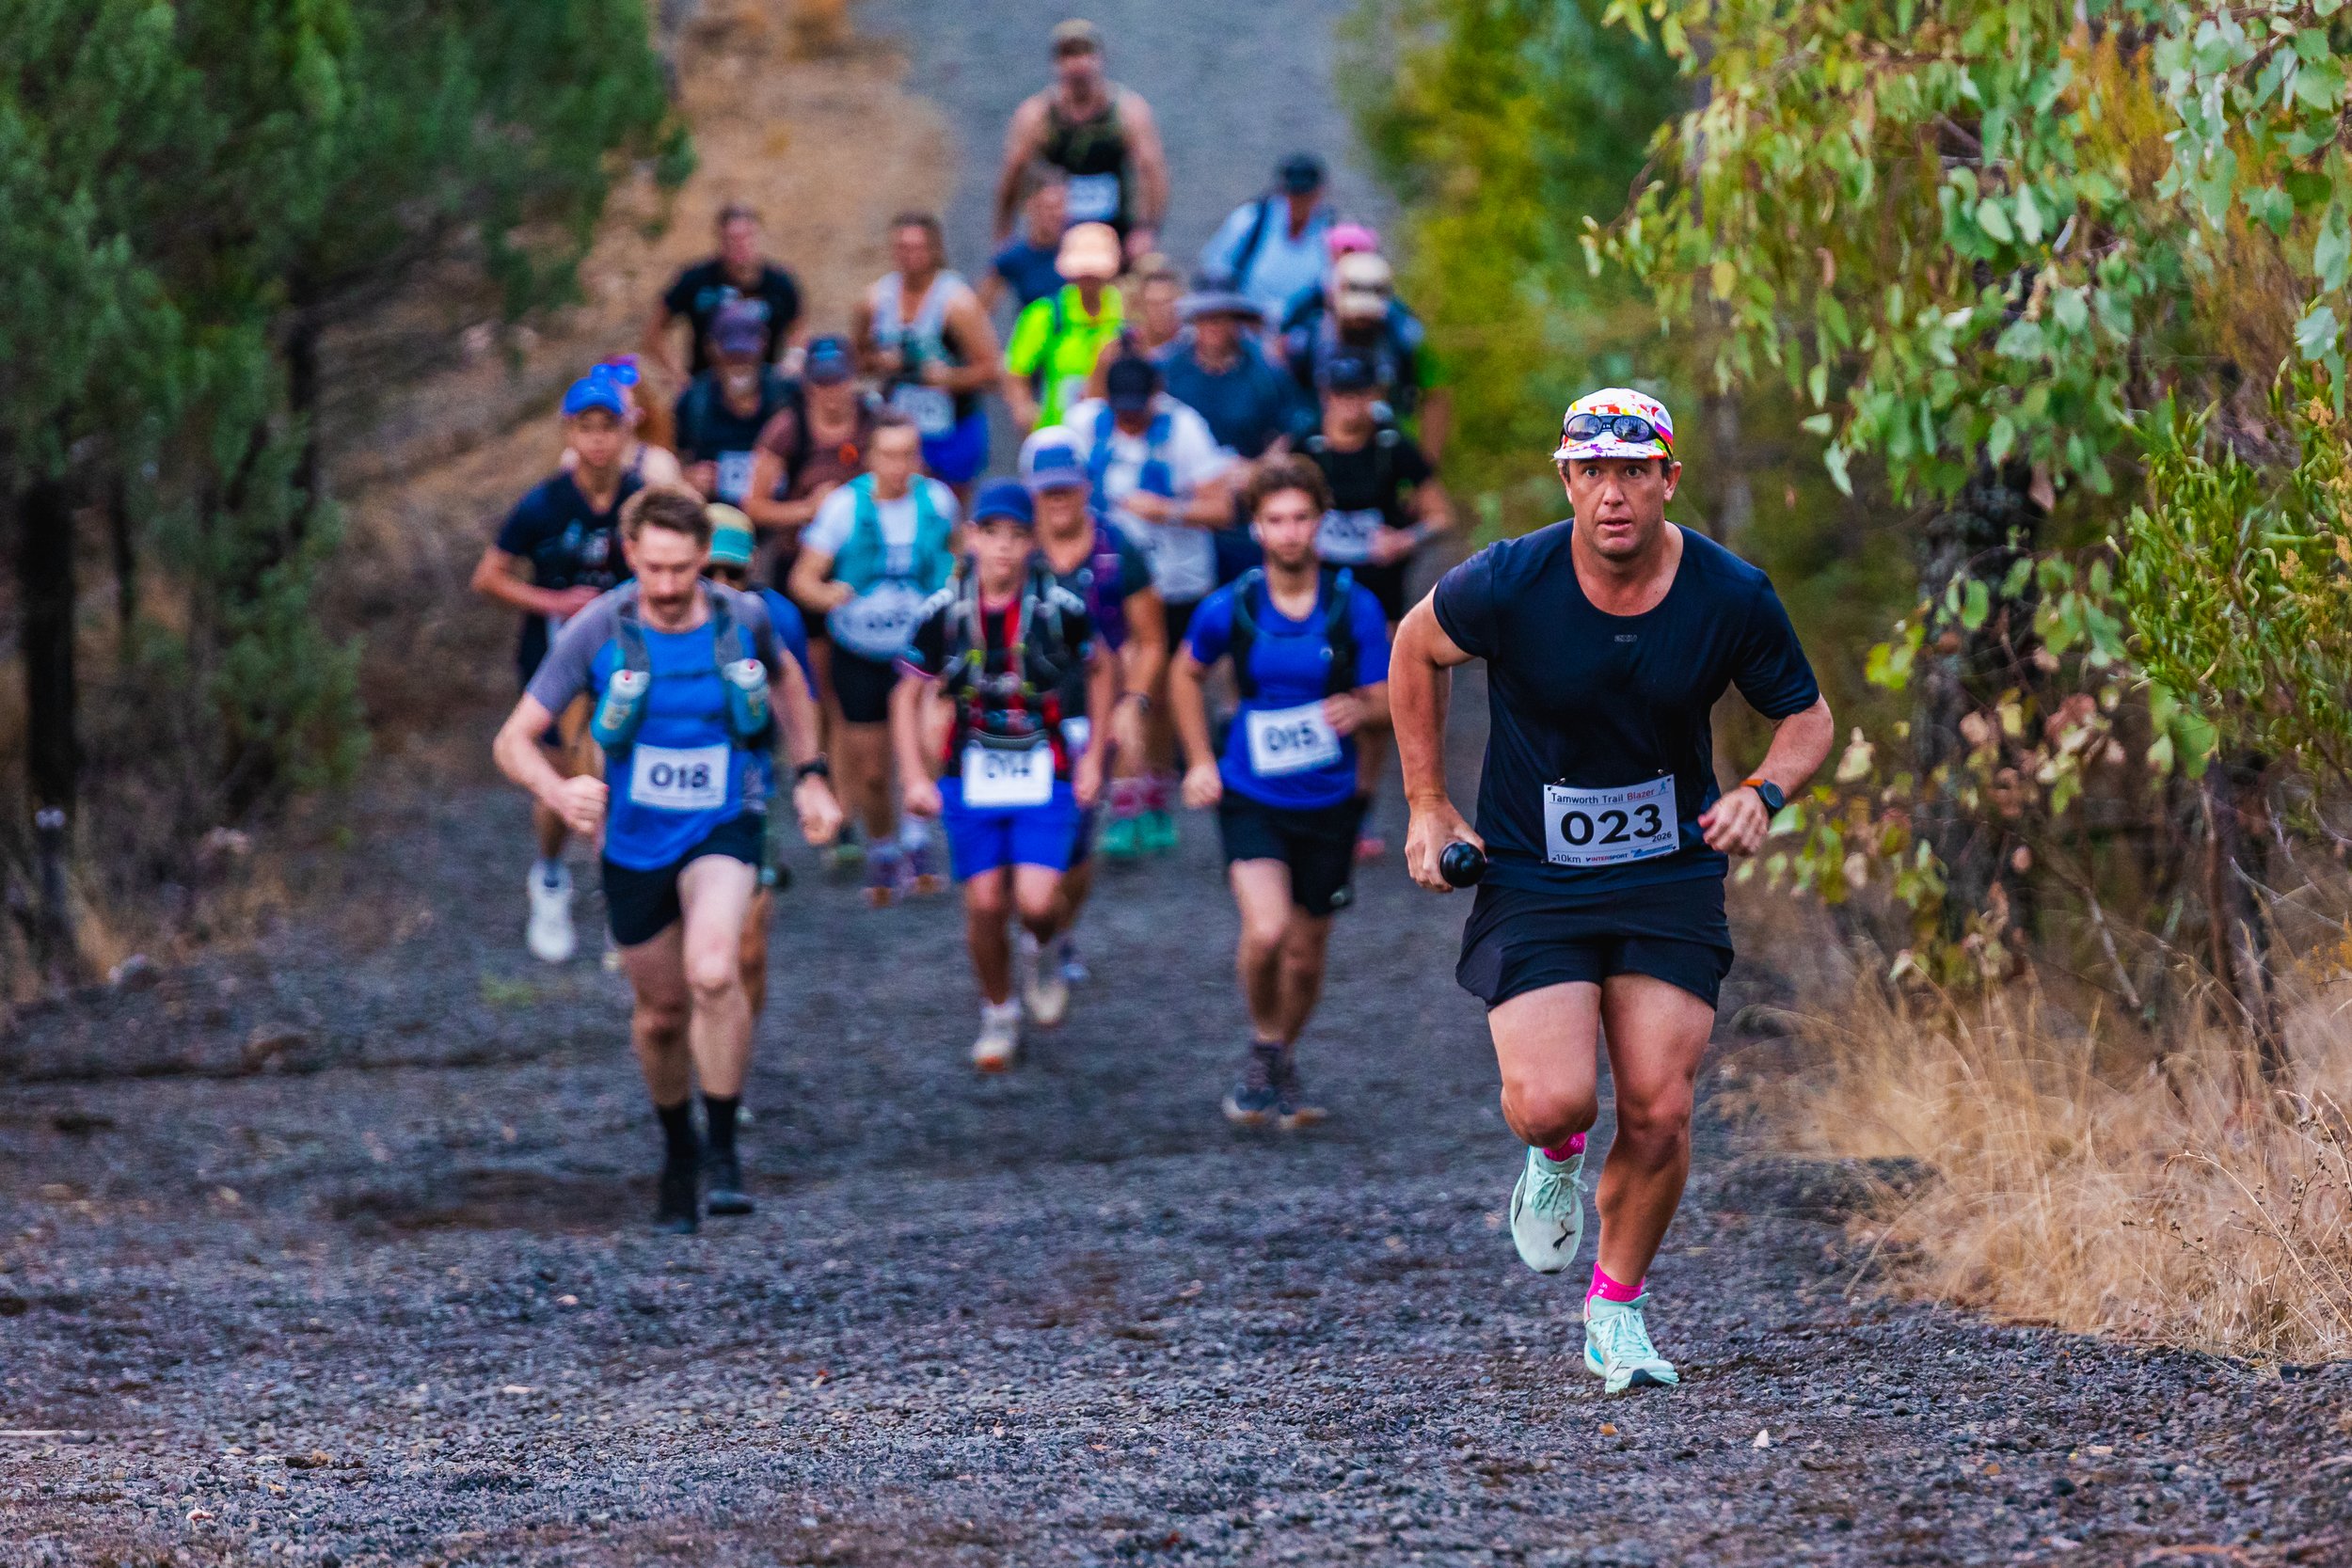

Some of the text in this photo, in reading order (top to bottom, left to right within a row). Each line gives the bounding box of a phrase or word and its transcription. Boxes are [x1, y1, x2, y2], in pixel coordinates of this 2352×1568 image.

[1263, 721, 1320, 754] 015
[649, 762, 710, 789] 018
[1551, 788, 1656, 804] Tamworth Trail Blazer
[1560, 803, 1662, 846] 023
[1651, 831, 1672, 843] 2026
[1555, 853, 1581, 863] 10km
